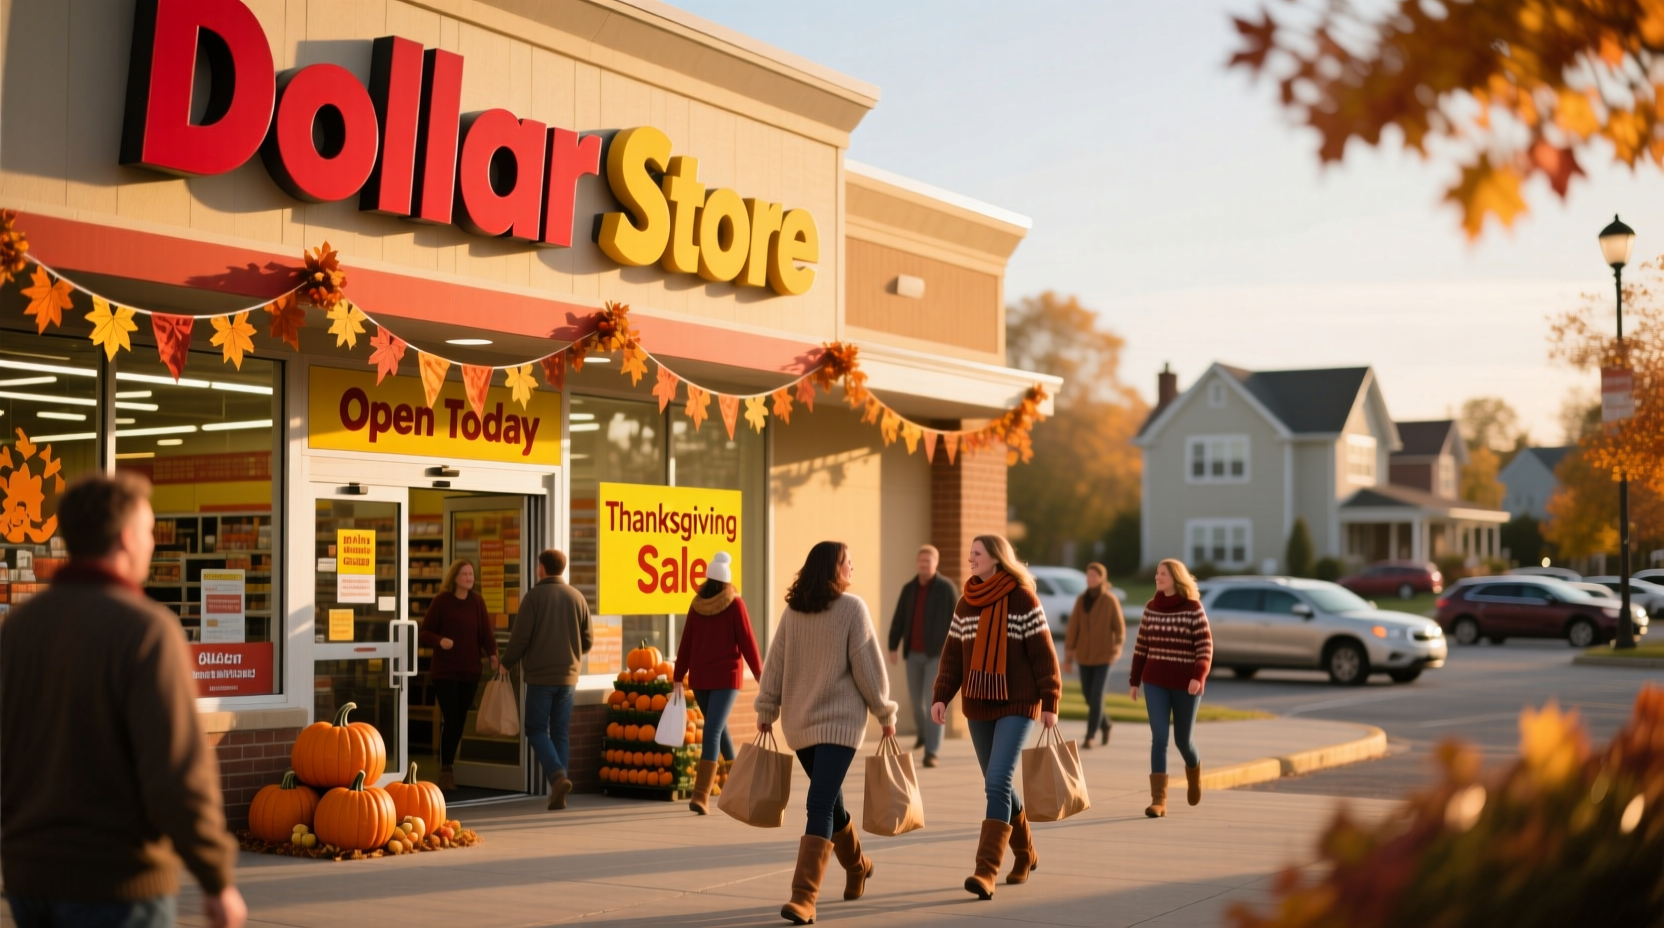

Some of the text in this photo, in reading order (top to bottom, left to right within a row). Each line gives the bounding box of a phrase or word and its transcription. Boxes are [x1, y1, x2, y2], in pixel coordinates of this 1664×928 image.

[126, 0, 820, 297] Dollar Store
[339, 386, 541, 456] Open Today
[605, 500, 737, 543] Thanksgiving
[637, 544, 708, 594] Sale
